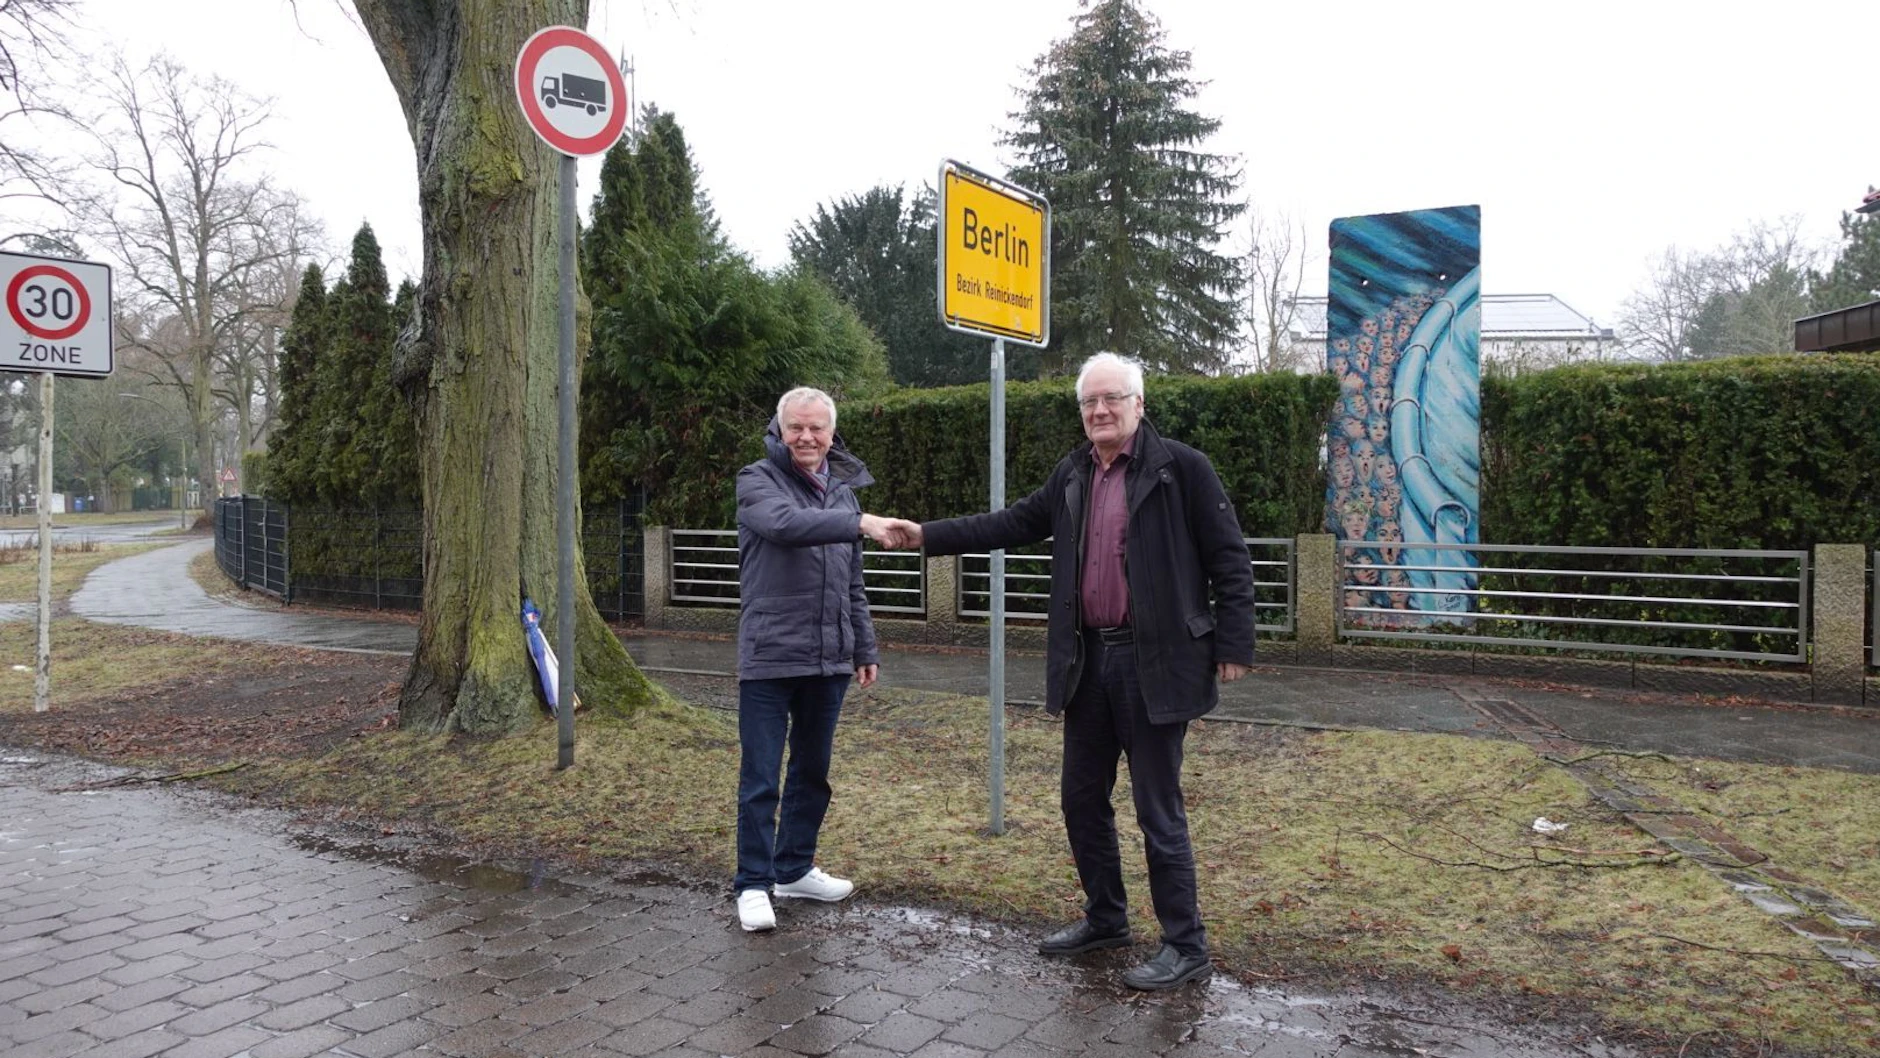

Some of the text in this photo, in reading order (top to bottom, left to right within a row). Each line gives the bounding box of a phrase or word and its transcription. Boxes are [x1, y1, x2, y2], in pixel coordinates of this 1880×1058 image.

[964, 208, 1029, 268] Berlin
[26, 285, 73, 320] 30
[957, 273, 1034, 310] Bezirk Reinickendorf
[20, 344, 82, 364] ZONE
